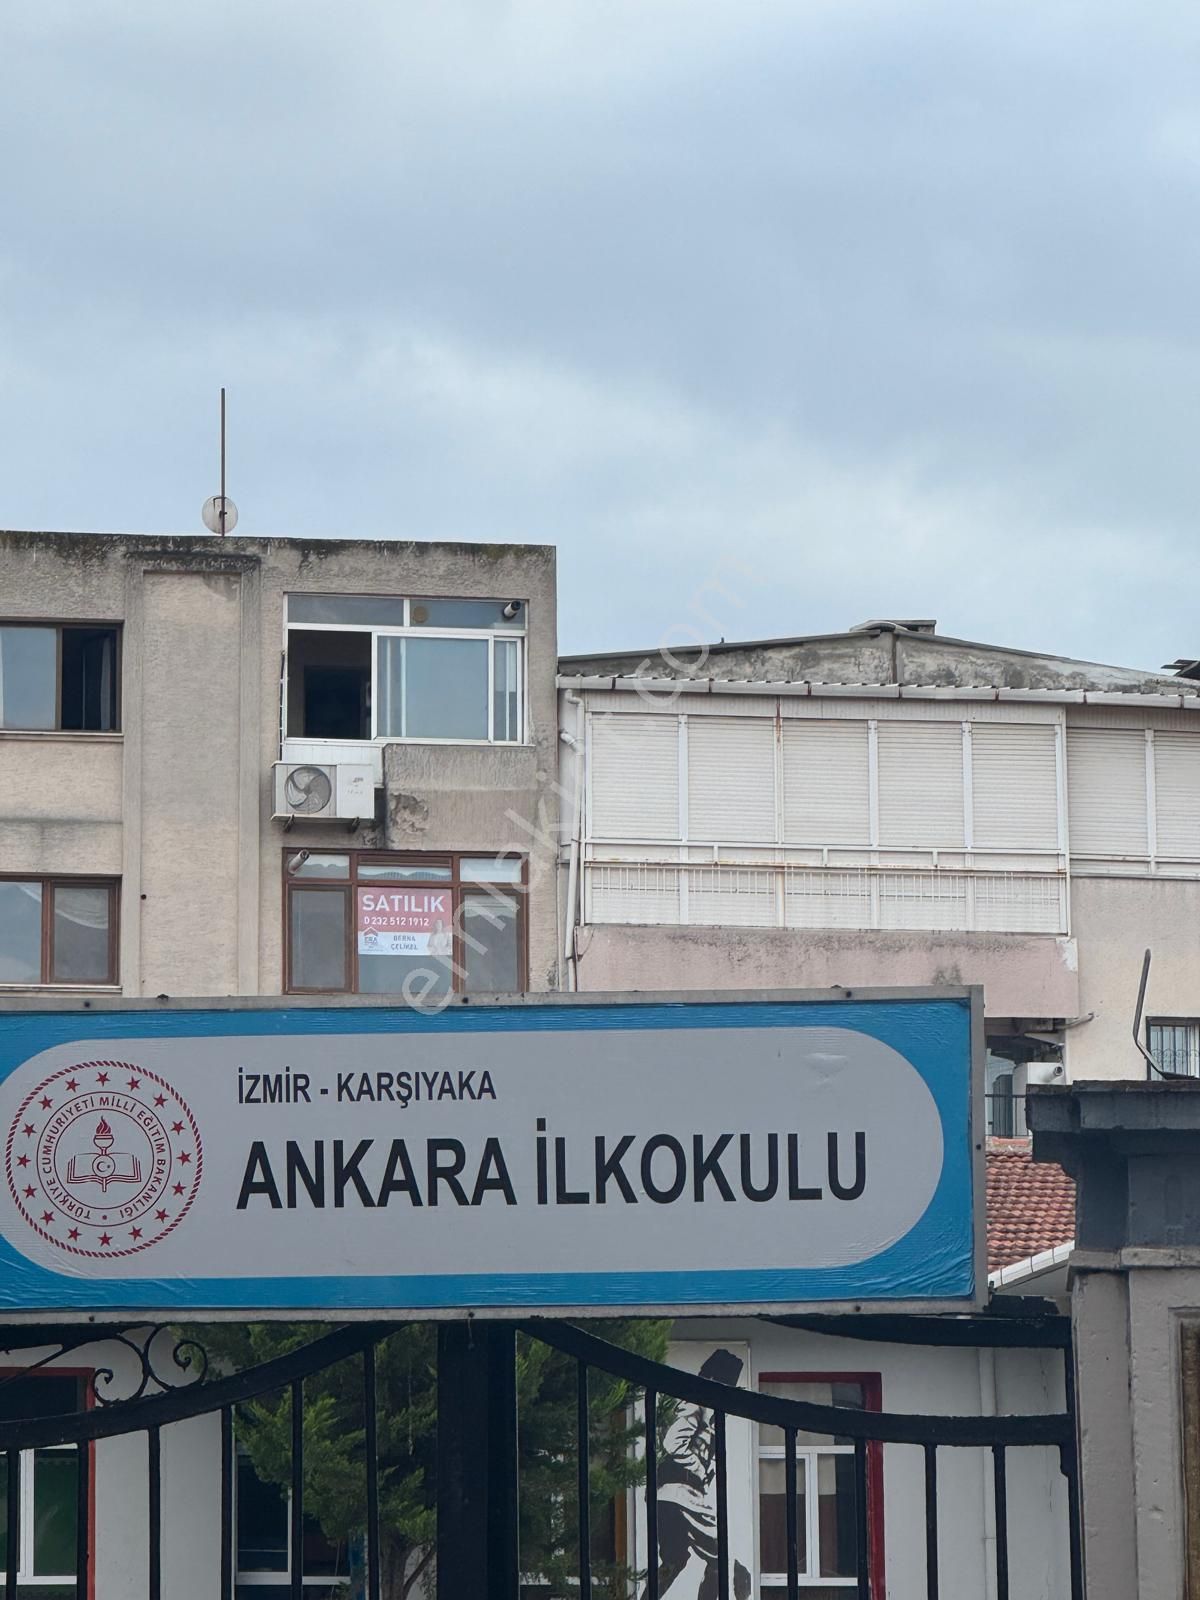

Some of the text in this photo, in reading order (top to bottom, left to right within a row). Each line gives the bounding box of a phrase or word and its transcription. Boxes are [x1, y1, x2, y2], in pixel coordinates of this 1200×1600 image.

[362, 894, 445, 913] SATILIK
[364, 916, 370, 925] 0
[389, 917, 407, 927] 512
[408, 918, 430, 927] 1912
[238, 1066, 310, 1104] İZMİR
[337, 1070, 496, 1108] KARŞIYAKA
[42, 1095, 167, 1219] TÜRKİYE CUMHURİYETİ MİLLİ EĞİTİM BAKANLIĞI
[237, 1118, 867, 1209] ANKARA İLKOKULU
